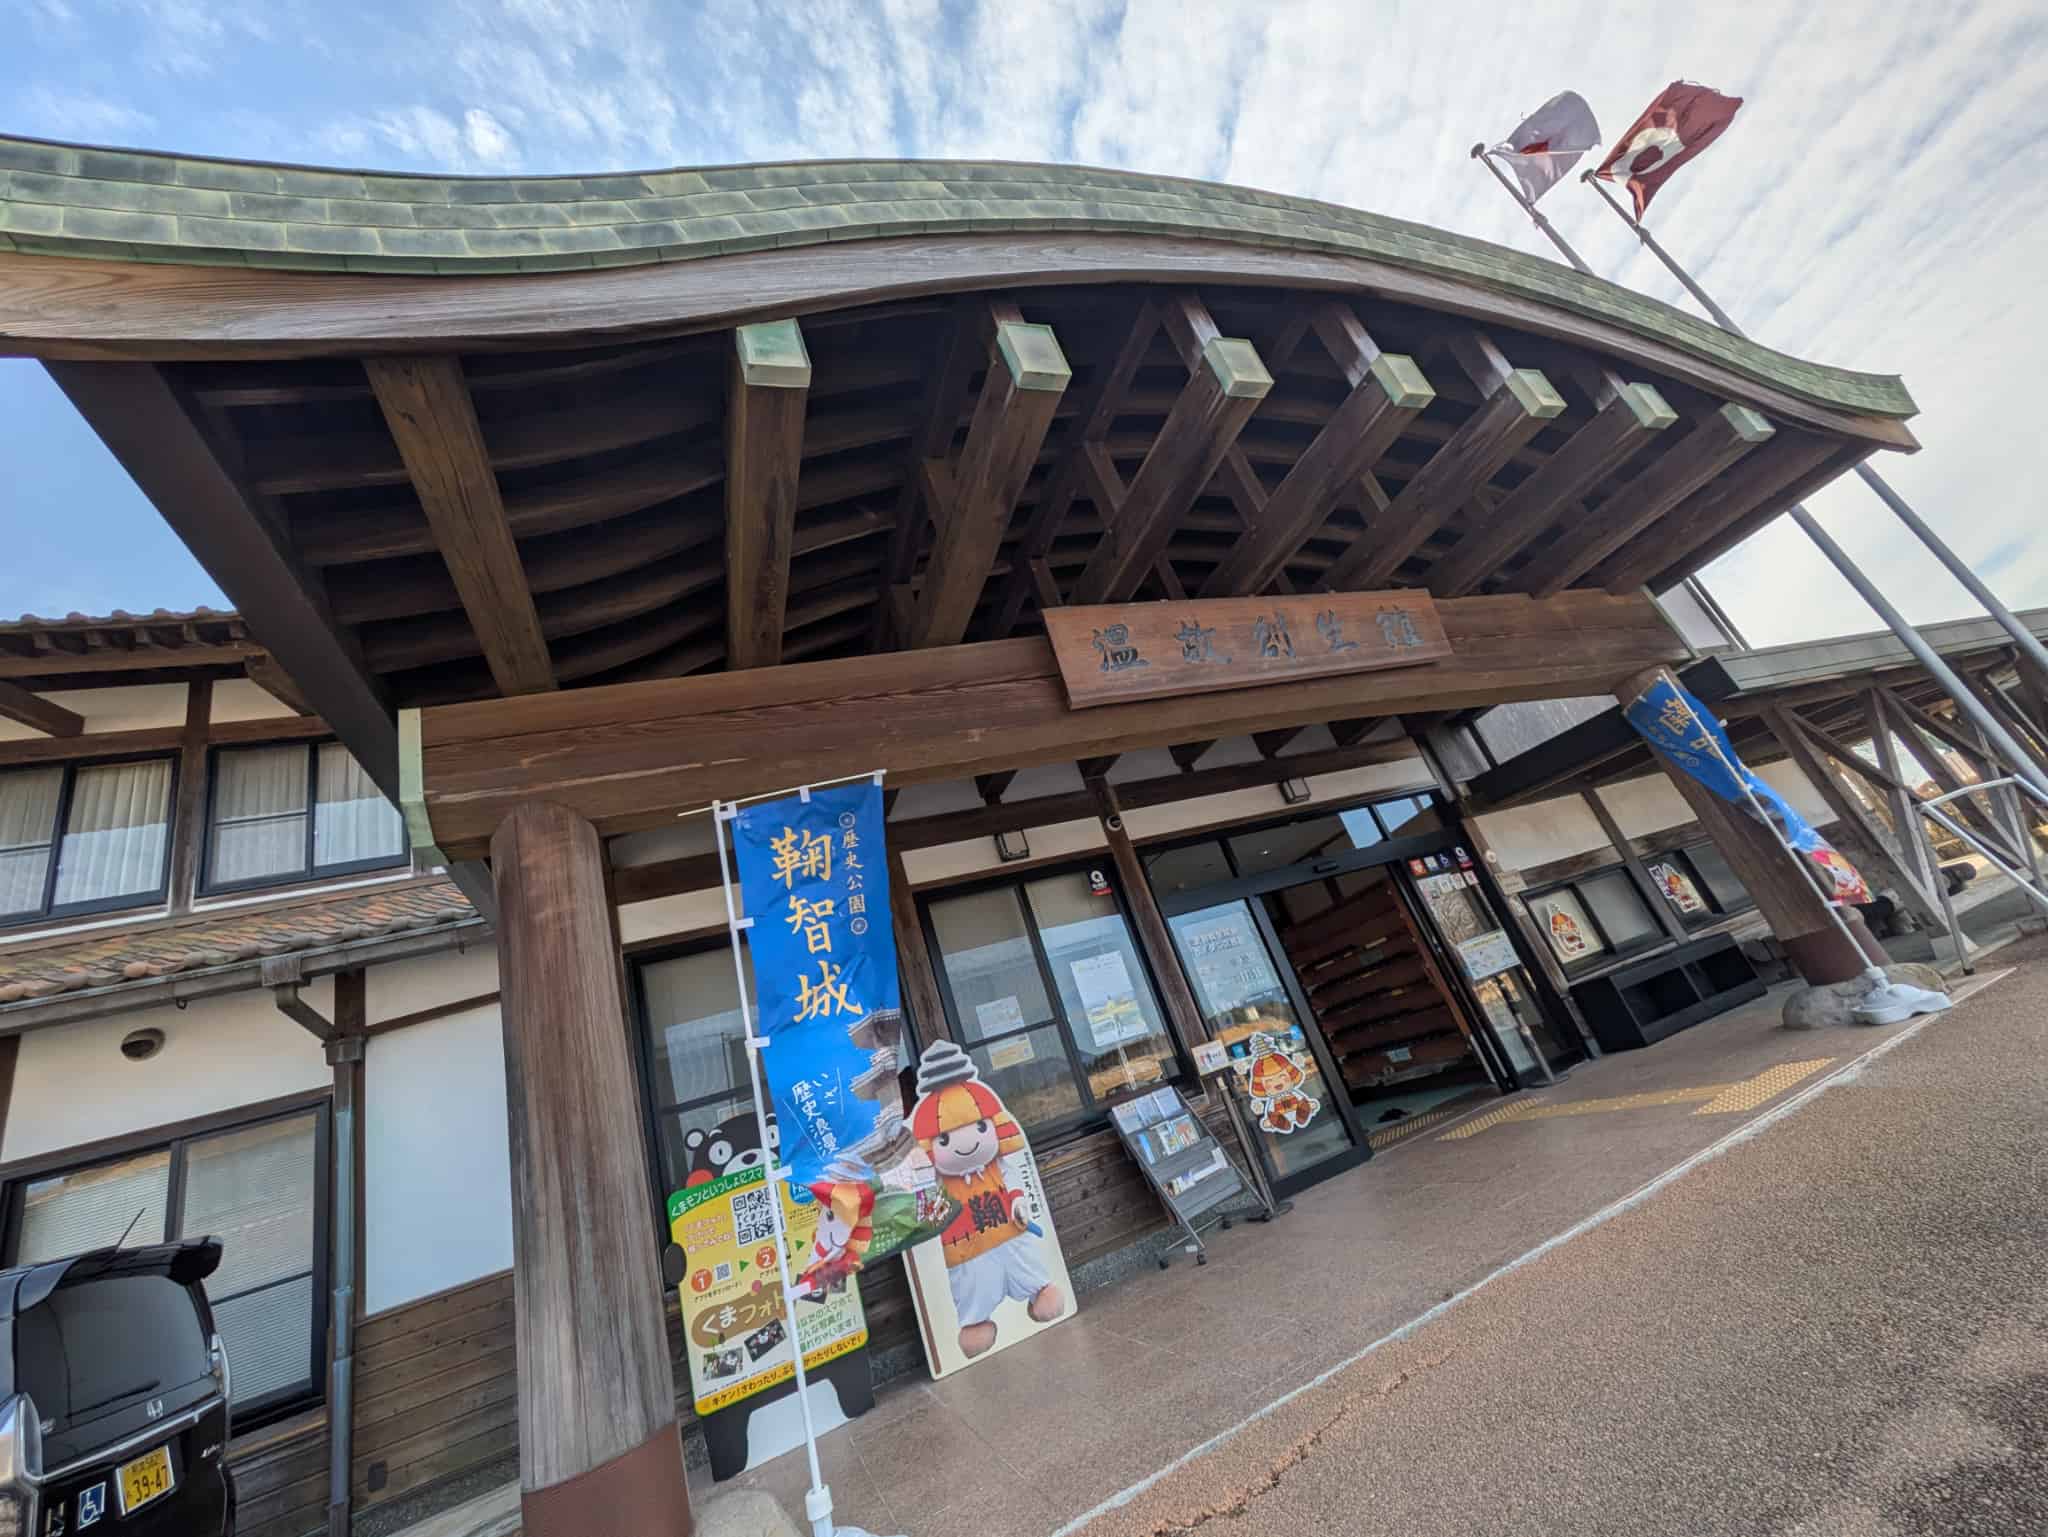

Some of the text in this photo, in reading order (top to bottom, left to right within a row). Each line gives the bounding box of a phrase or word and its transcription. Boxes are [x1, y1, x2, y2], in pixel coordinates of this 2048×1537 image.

[841, 829, 866, 913] 歴史公園
[770, 826, 865, 1023] 鞠智城
[762, 1254, 772, 1267] 2
[699, 1277, 706, 1290] 1
[702, 1289, 783, 1334] くまフォト
